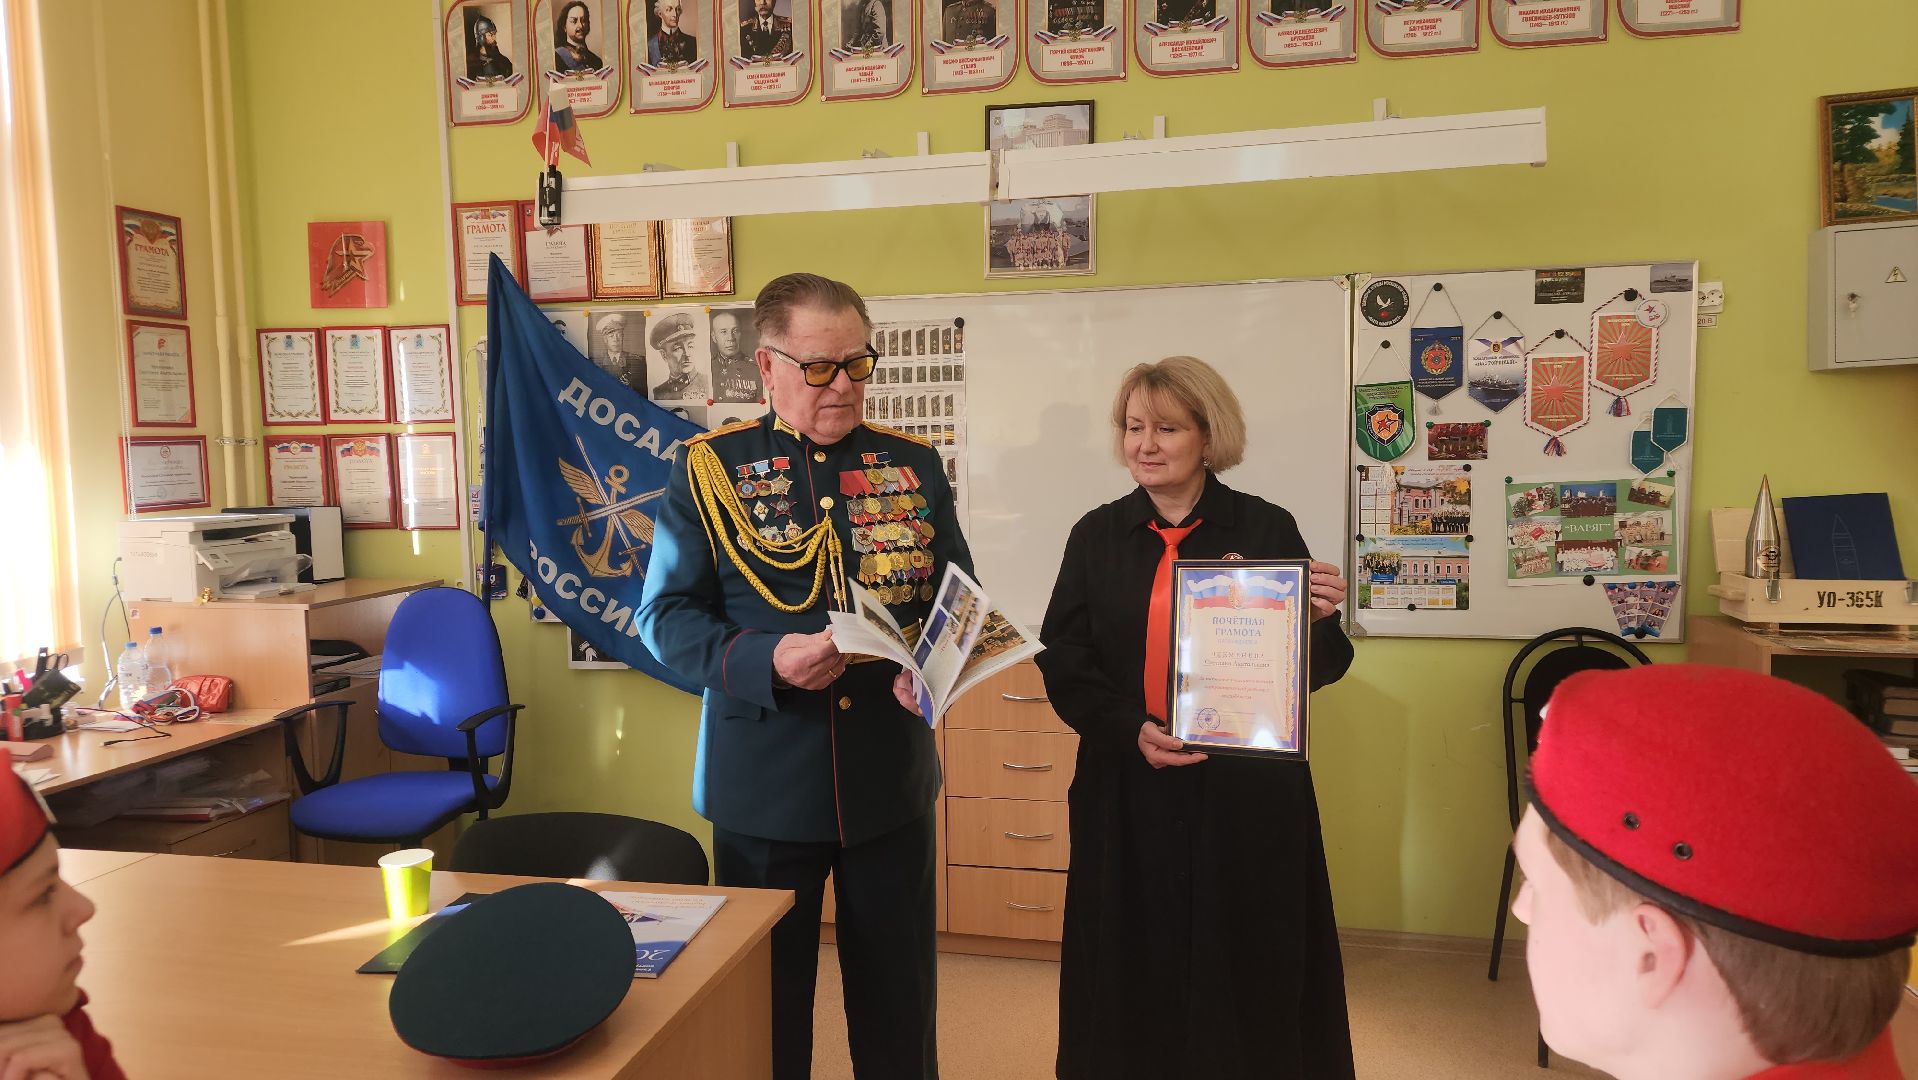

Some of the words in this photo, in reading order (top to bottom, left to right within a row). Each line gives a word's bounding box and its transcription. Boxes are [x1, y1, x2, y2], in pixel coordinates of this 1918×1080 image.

[466, 223, 507, 235] ГРАМОТА
[134, 243, 170, 256] ГРАМОТА
[1215, 627, 1262, 637] ГРАМОТА
